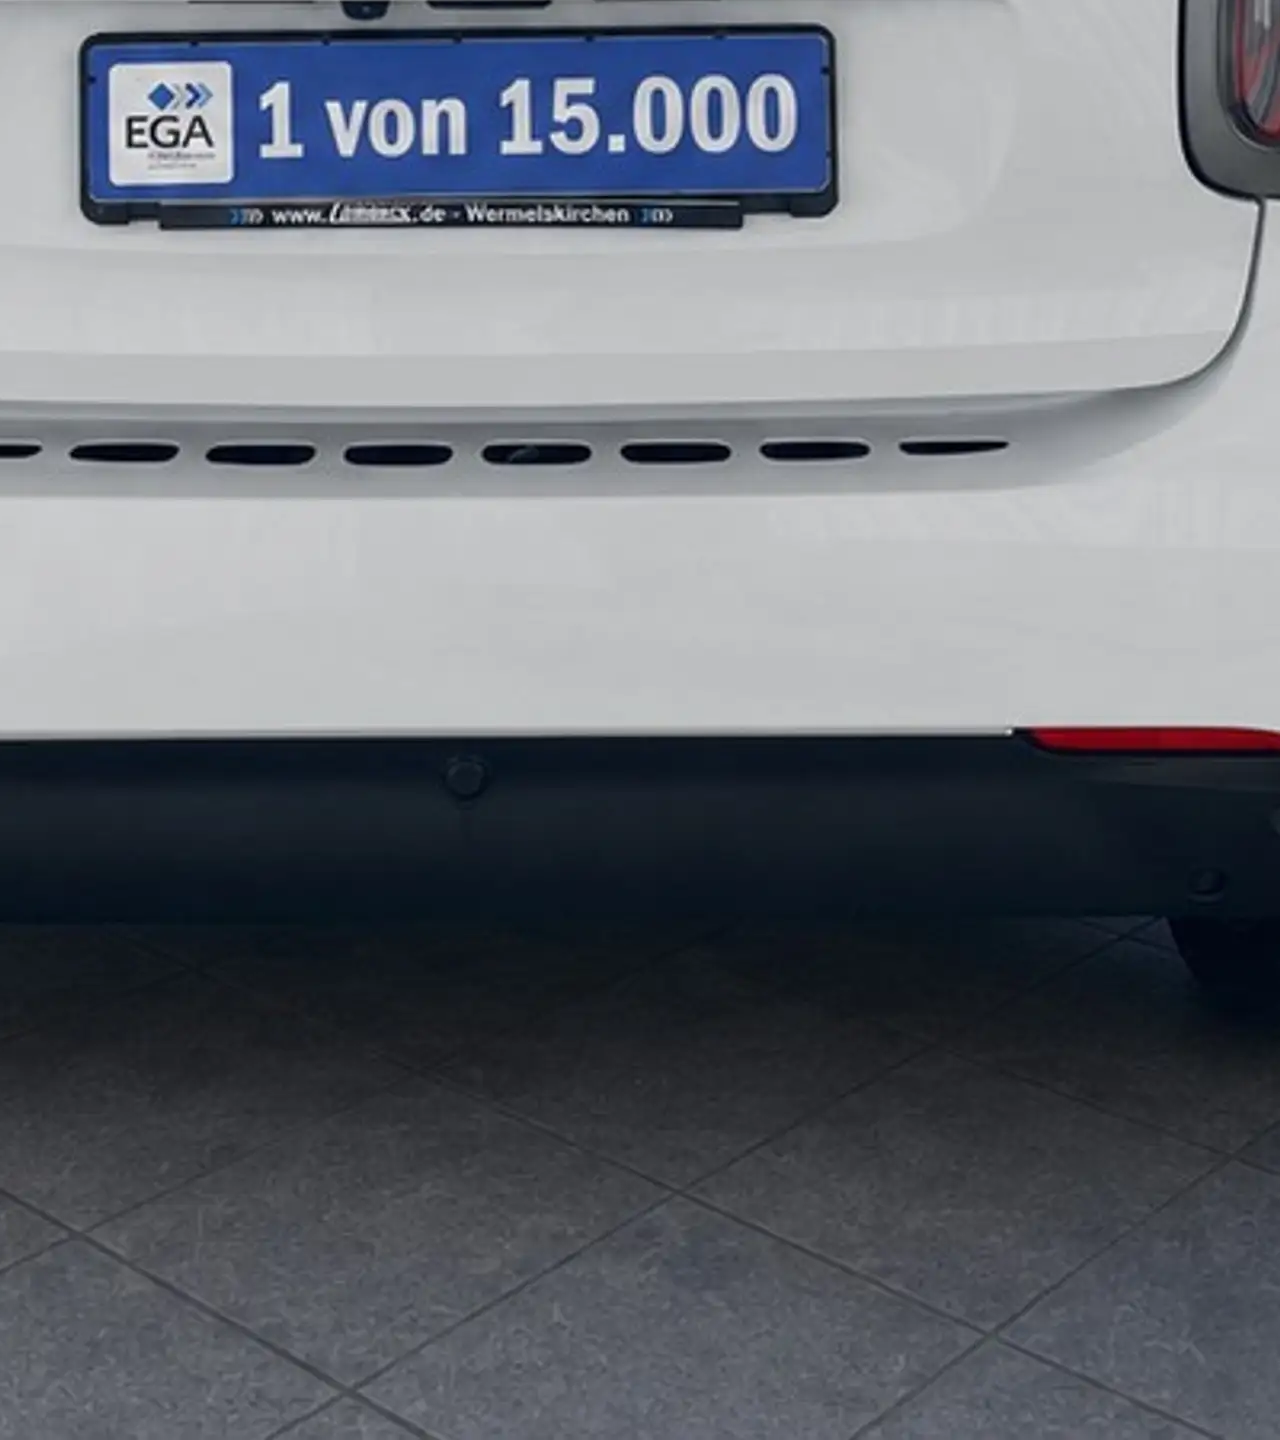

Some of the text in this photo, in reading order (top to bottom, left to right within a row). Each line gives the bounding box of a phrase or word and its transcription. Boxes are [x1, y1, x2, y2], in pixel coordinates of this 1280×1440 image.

[125, 114, 215, 149] EGA
[258, 72, 800, 159] 1 von 15.000
[464, 203, 630, 223] Wermelskirchen
